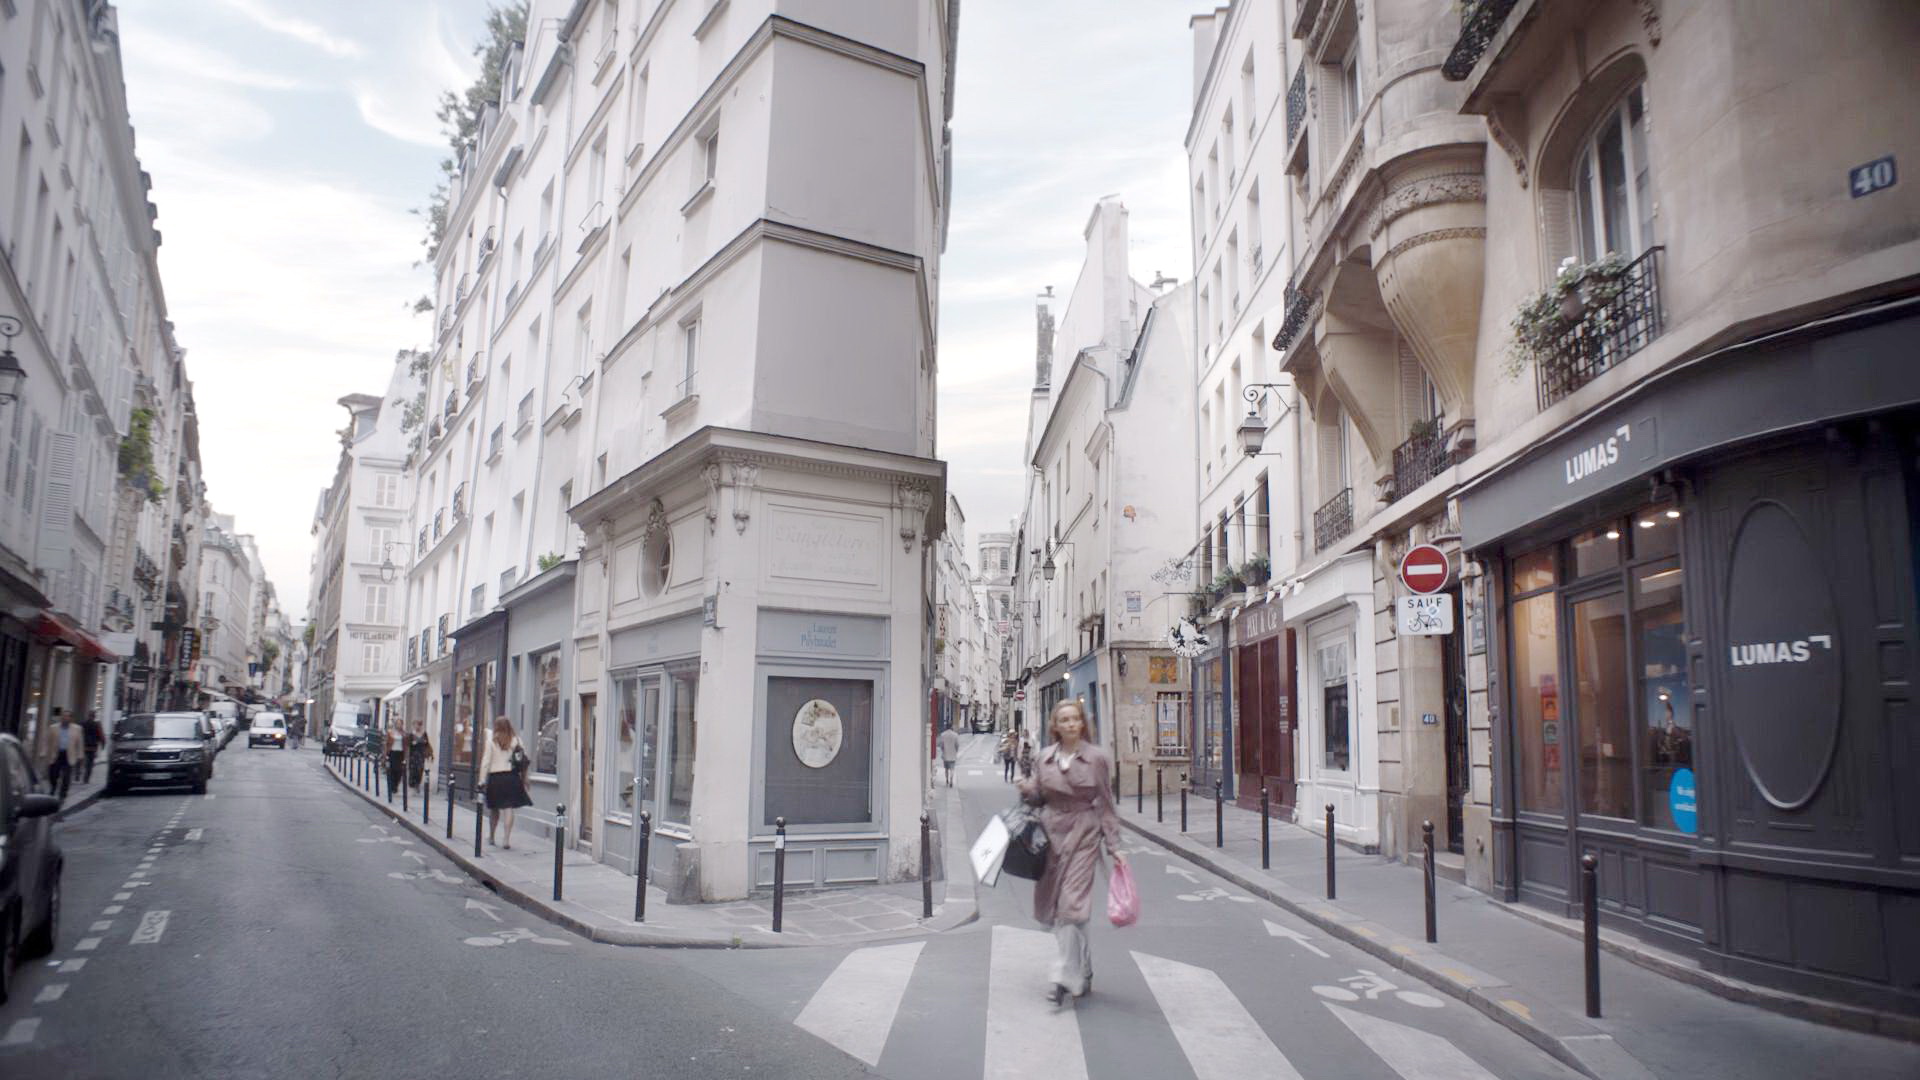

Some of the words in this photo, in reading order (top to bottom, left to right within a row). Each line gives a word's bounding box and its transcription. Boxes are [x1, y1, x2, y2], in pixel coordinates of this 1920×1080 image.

[1854, 162, 1892, 193] 40
[1566, 437, 1618, 484] LUMAS
[1407, 597, 1442, 608] SAUF
[350, 631, 369, 640] HOTEL
[1730, 640, 1810, 666] LUMAS
[1423, 714, 1435, 723] 40
